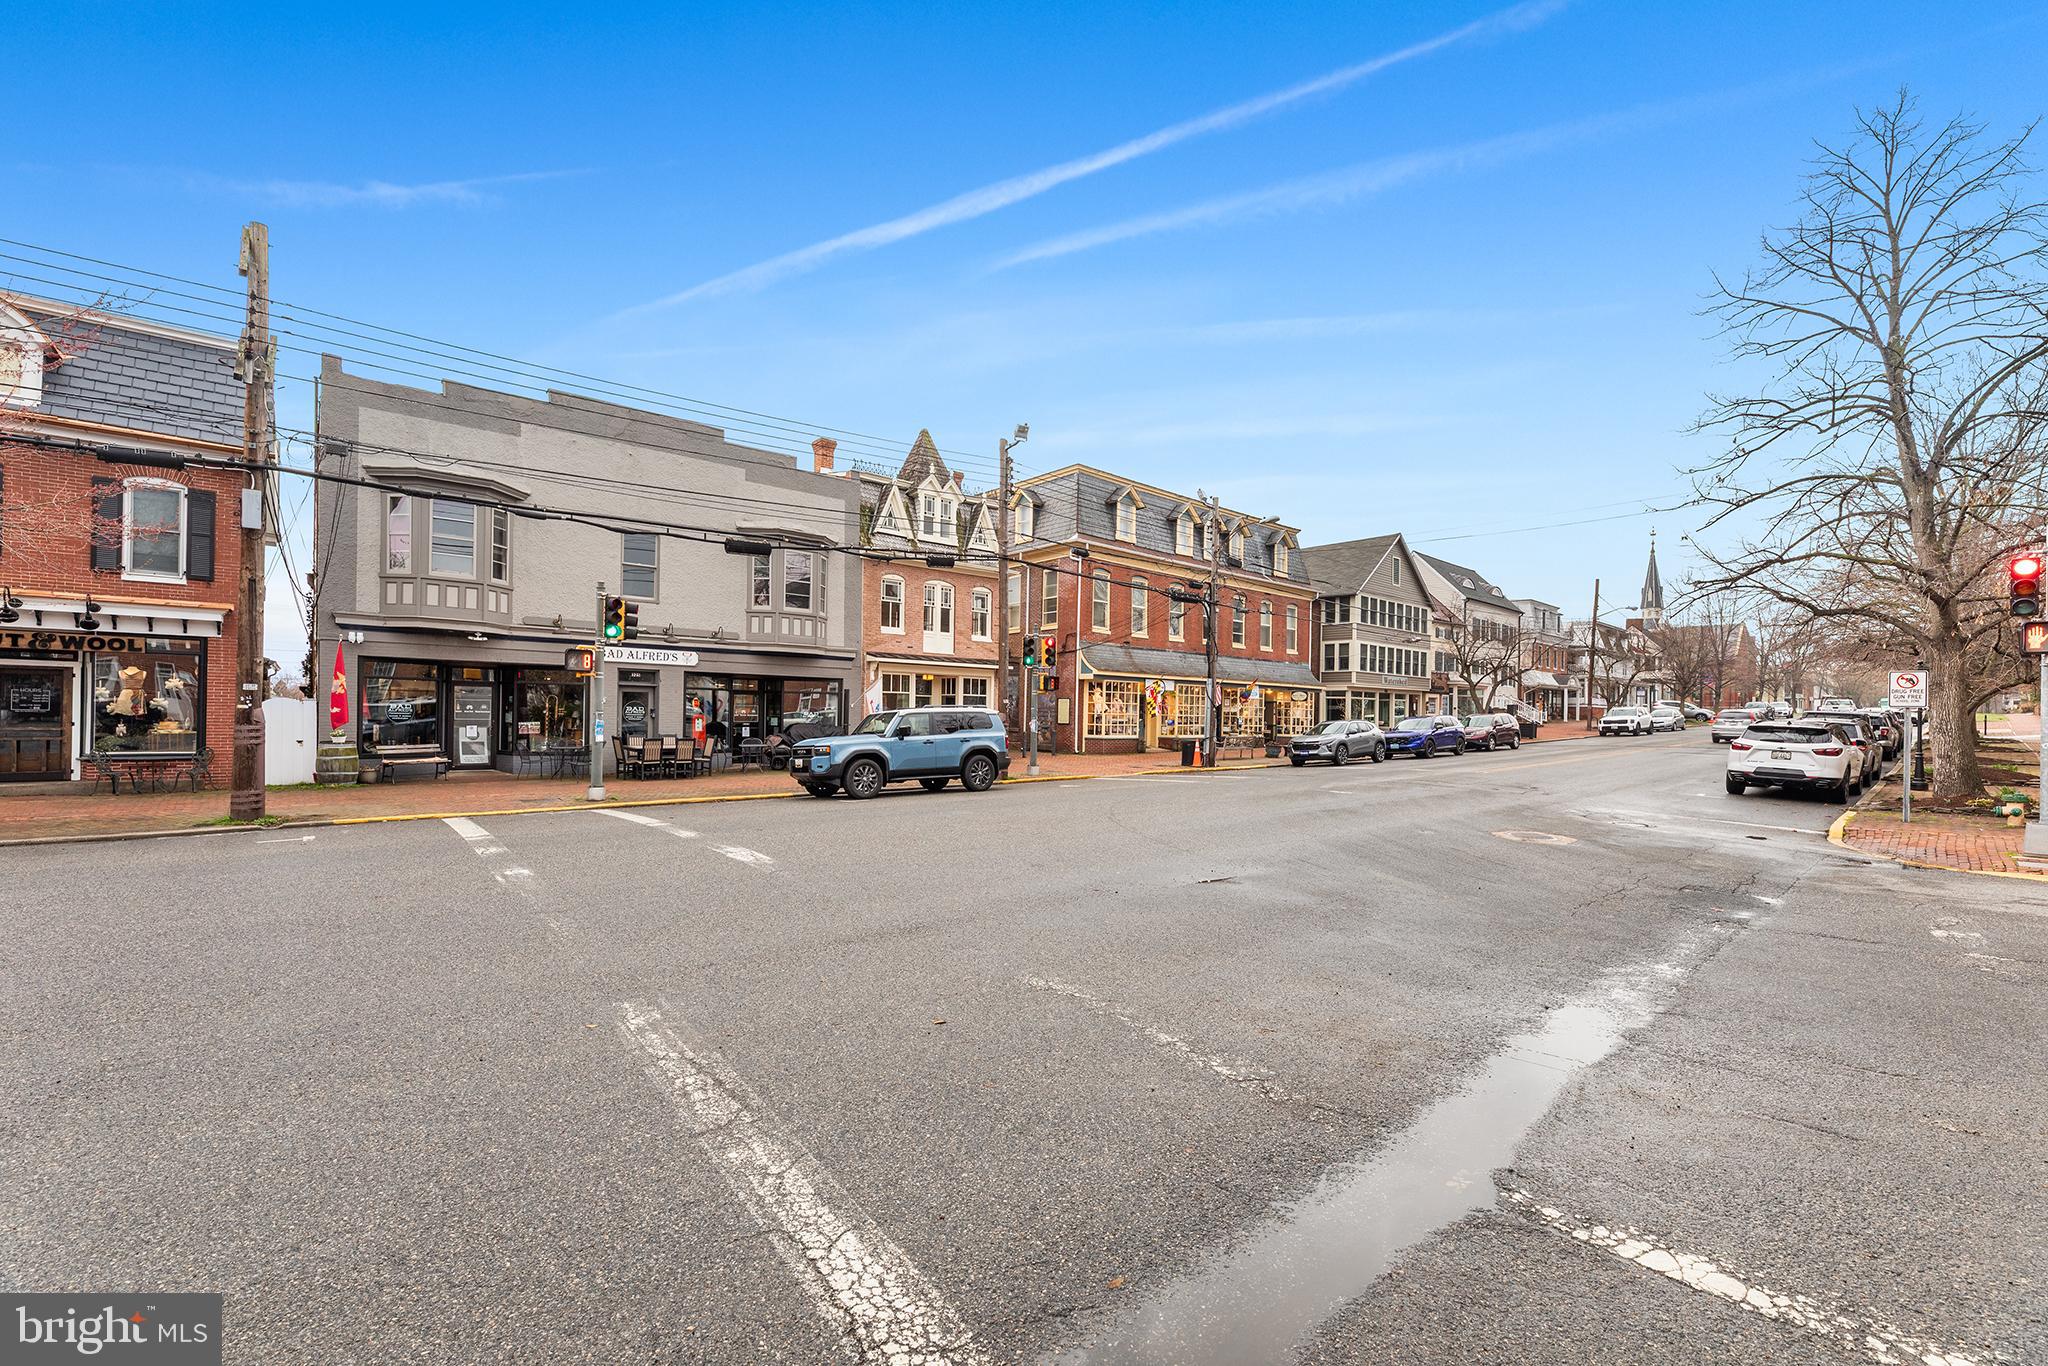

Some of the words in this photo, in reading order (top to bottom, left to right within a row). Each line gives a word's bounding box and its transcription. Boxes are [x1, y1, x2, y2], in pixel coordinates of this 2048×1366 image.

[59, 636, 142, 651] WOOL
[584, 654, 591, 668] 8
[626, 651, 679, 662] ALFRED'S
